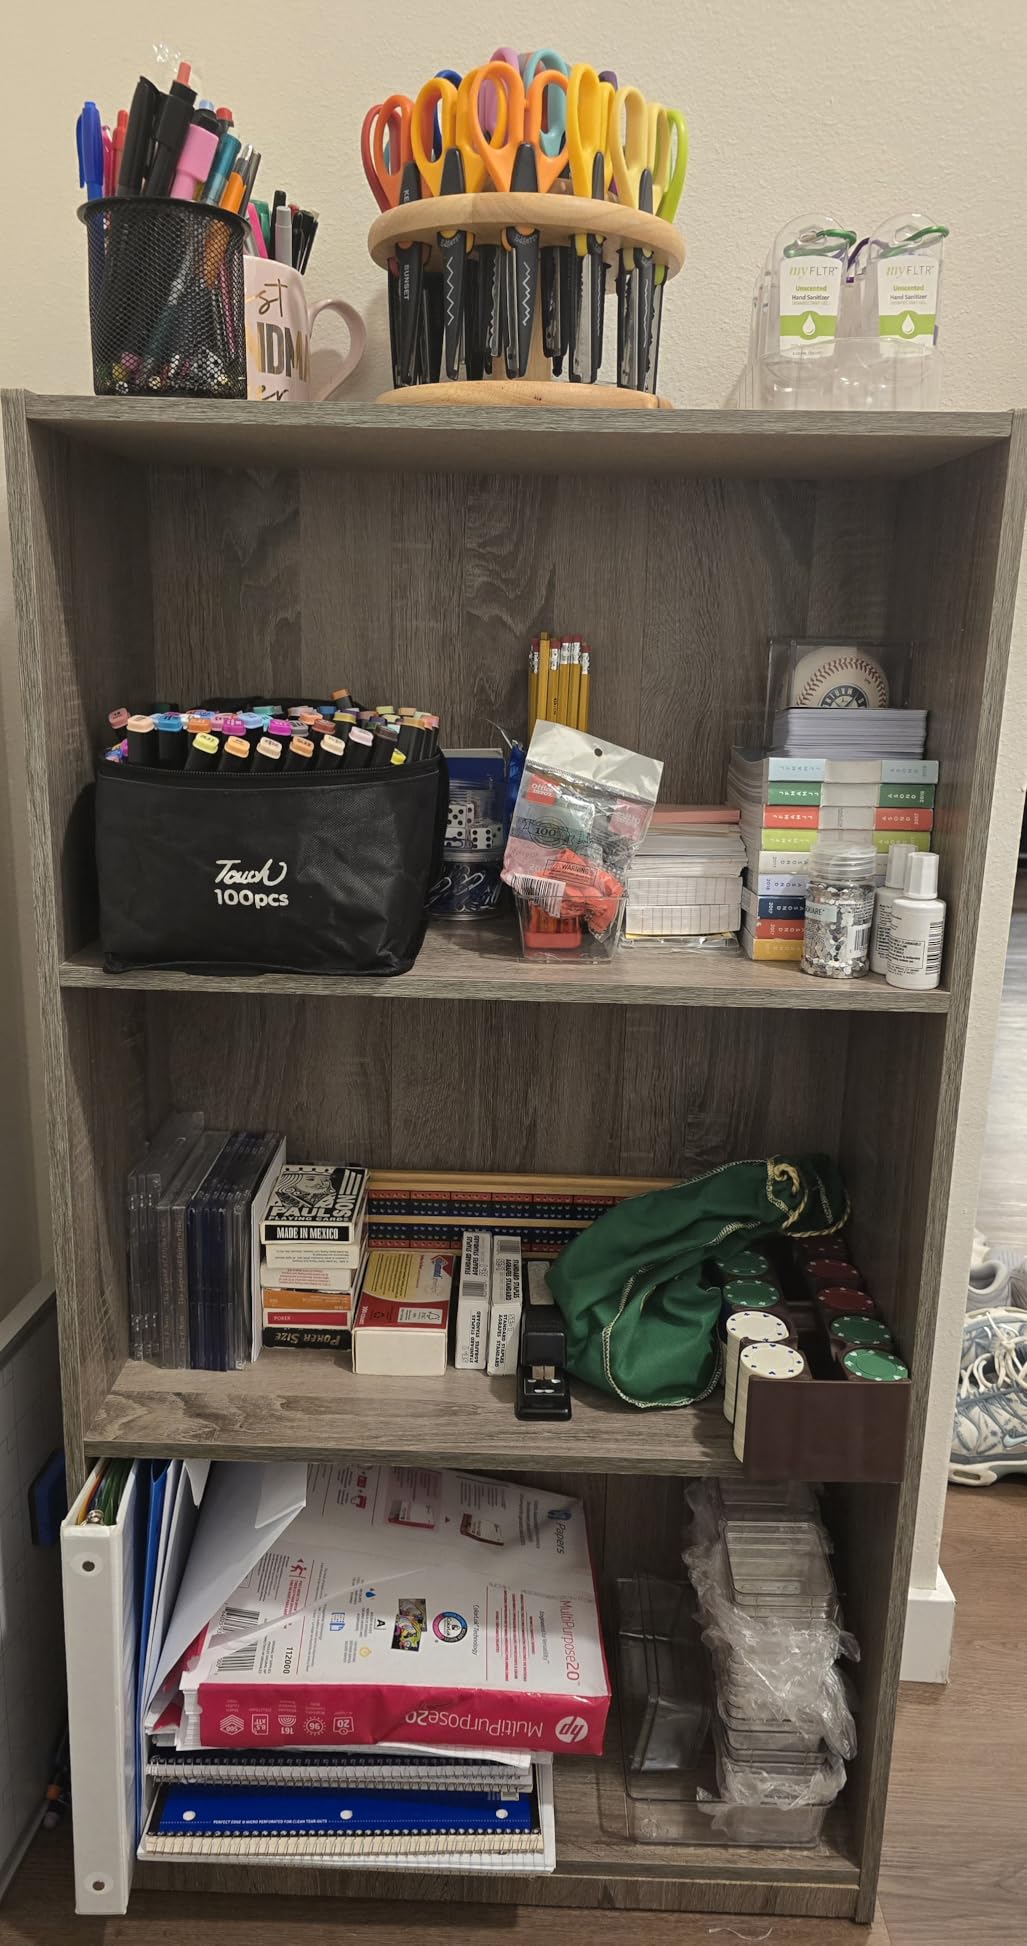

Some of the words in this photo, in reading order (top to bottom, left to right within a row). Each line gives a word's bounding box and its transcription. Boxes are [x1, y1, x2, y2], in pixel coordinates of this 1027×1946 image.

[214, 858, 288, 886] Touch
[562, 864, 589, 874] WARNING
[214, 888, 289, 909] 100pcs
[270, 1206, 330, 1217] PAUL
[276, 1226, 298, 1239] MADE
[300, 1227, 308, 1239] IN
[310, 1228, 339, 1240] MEXICO
[556, 1524, 566, 1554] Papers
[377, 1619, 386, 1627] A
[283, 1647, 293, 1674] 112000
[337, 1720, 349, 1728] 20
[405, 1710, 543, 1737] MultiPurpose20
[556, 1716, 588, 1743] hp
